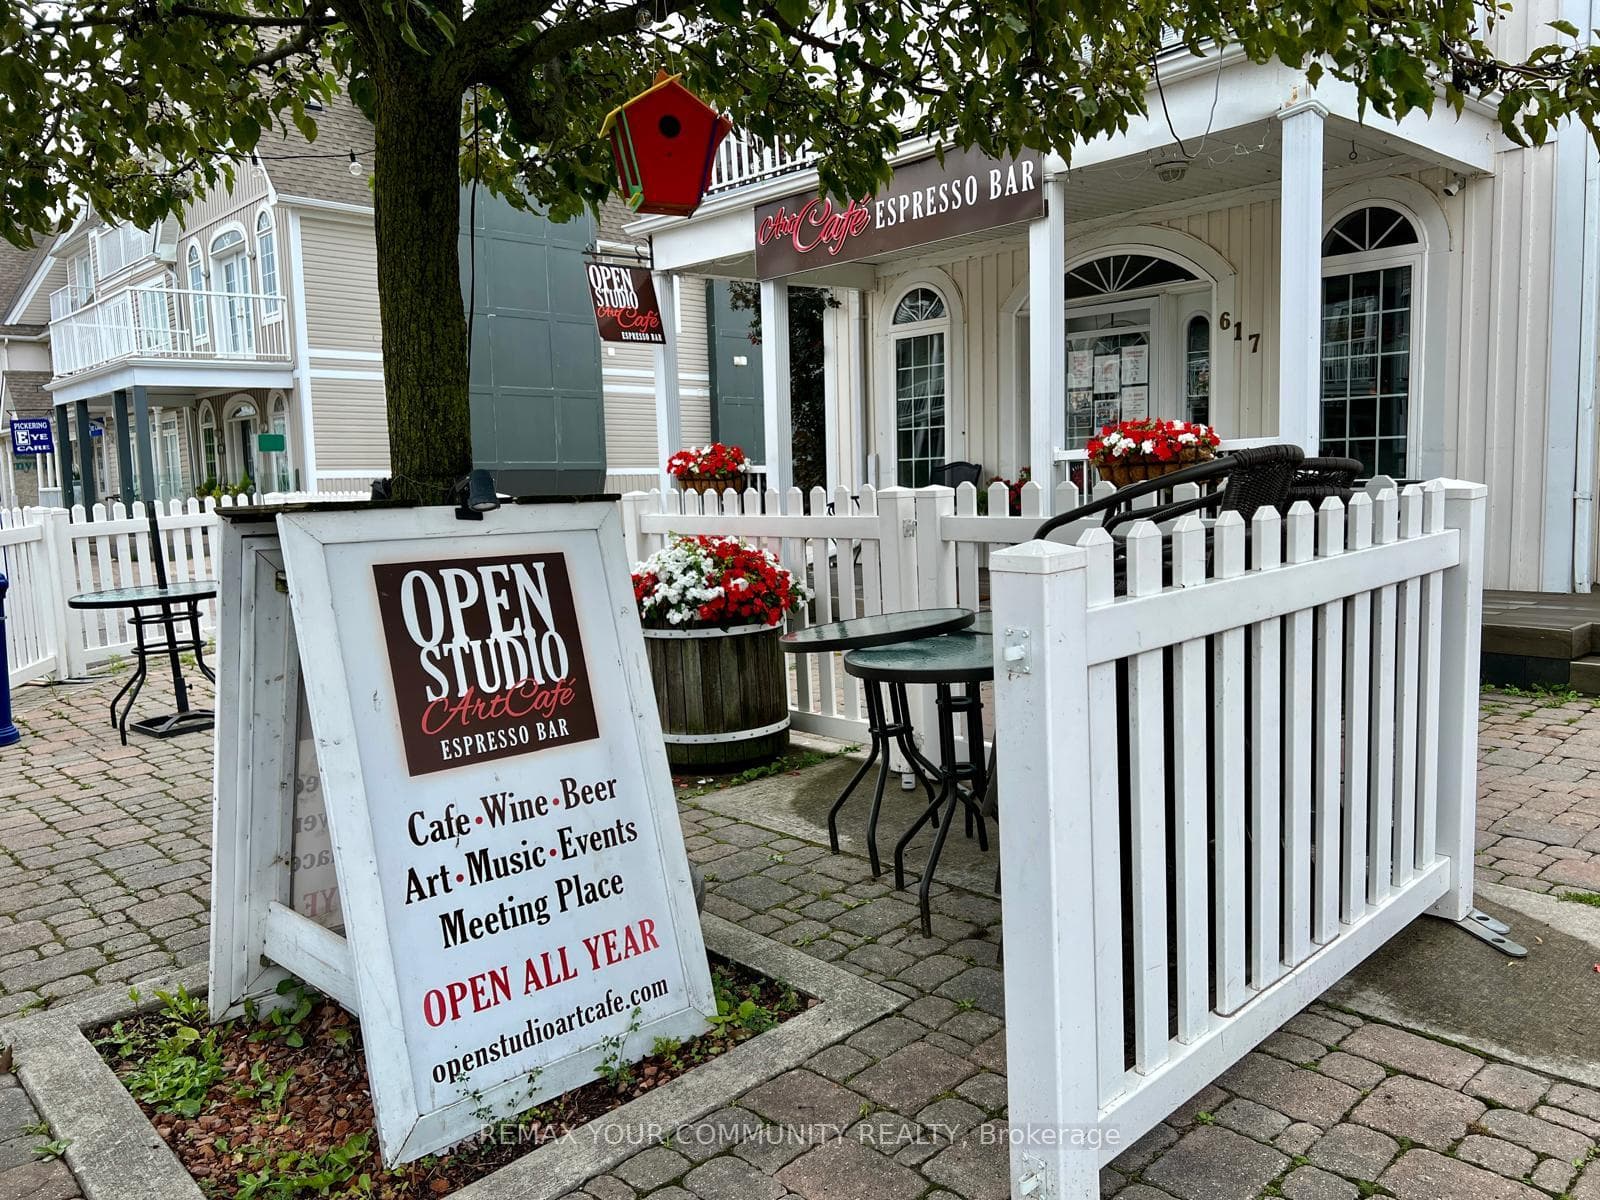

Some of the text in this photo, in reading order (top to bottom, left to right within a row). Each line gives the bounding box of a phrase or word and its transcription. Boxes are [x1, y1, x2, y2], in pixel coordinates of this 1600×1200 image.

[875, 175, 978, 230] ESPRESSO
[989, 160, 1036, 200] BAR
[588, 264, 634, 292] OPEN
[594, 287, 639, 310] STUDIO
[621, 331, 663, 342] ESPRESSO BAR
[1219, 311, 1260, 353] 617
[13, 422, 48, 430] PICKERING
[17, 444, 51, 452] CARE
[400, 561, 556, 650] OPEN
[419, 630, 570, 704] STUDIO
[440, 718, 570, 761] ESPRESSO BAR
[479, 791, 549, 829] Wine
[559, 776, 618, 810] Beer
[404, 818, 639, 905] Art Music Events
[438, 873, 625, 950] Meeting Place
[423, 917, 661, 1029] OPEN ALL YEAR
[431, 978, 670, 1085] openstudioartcafe.com
